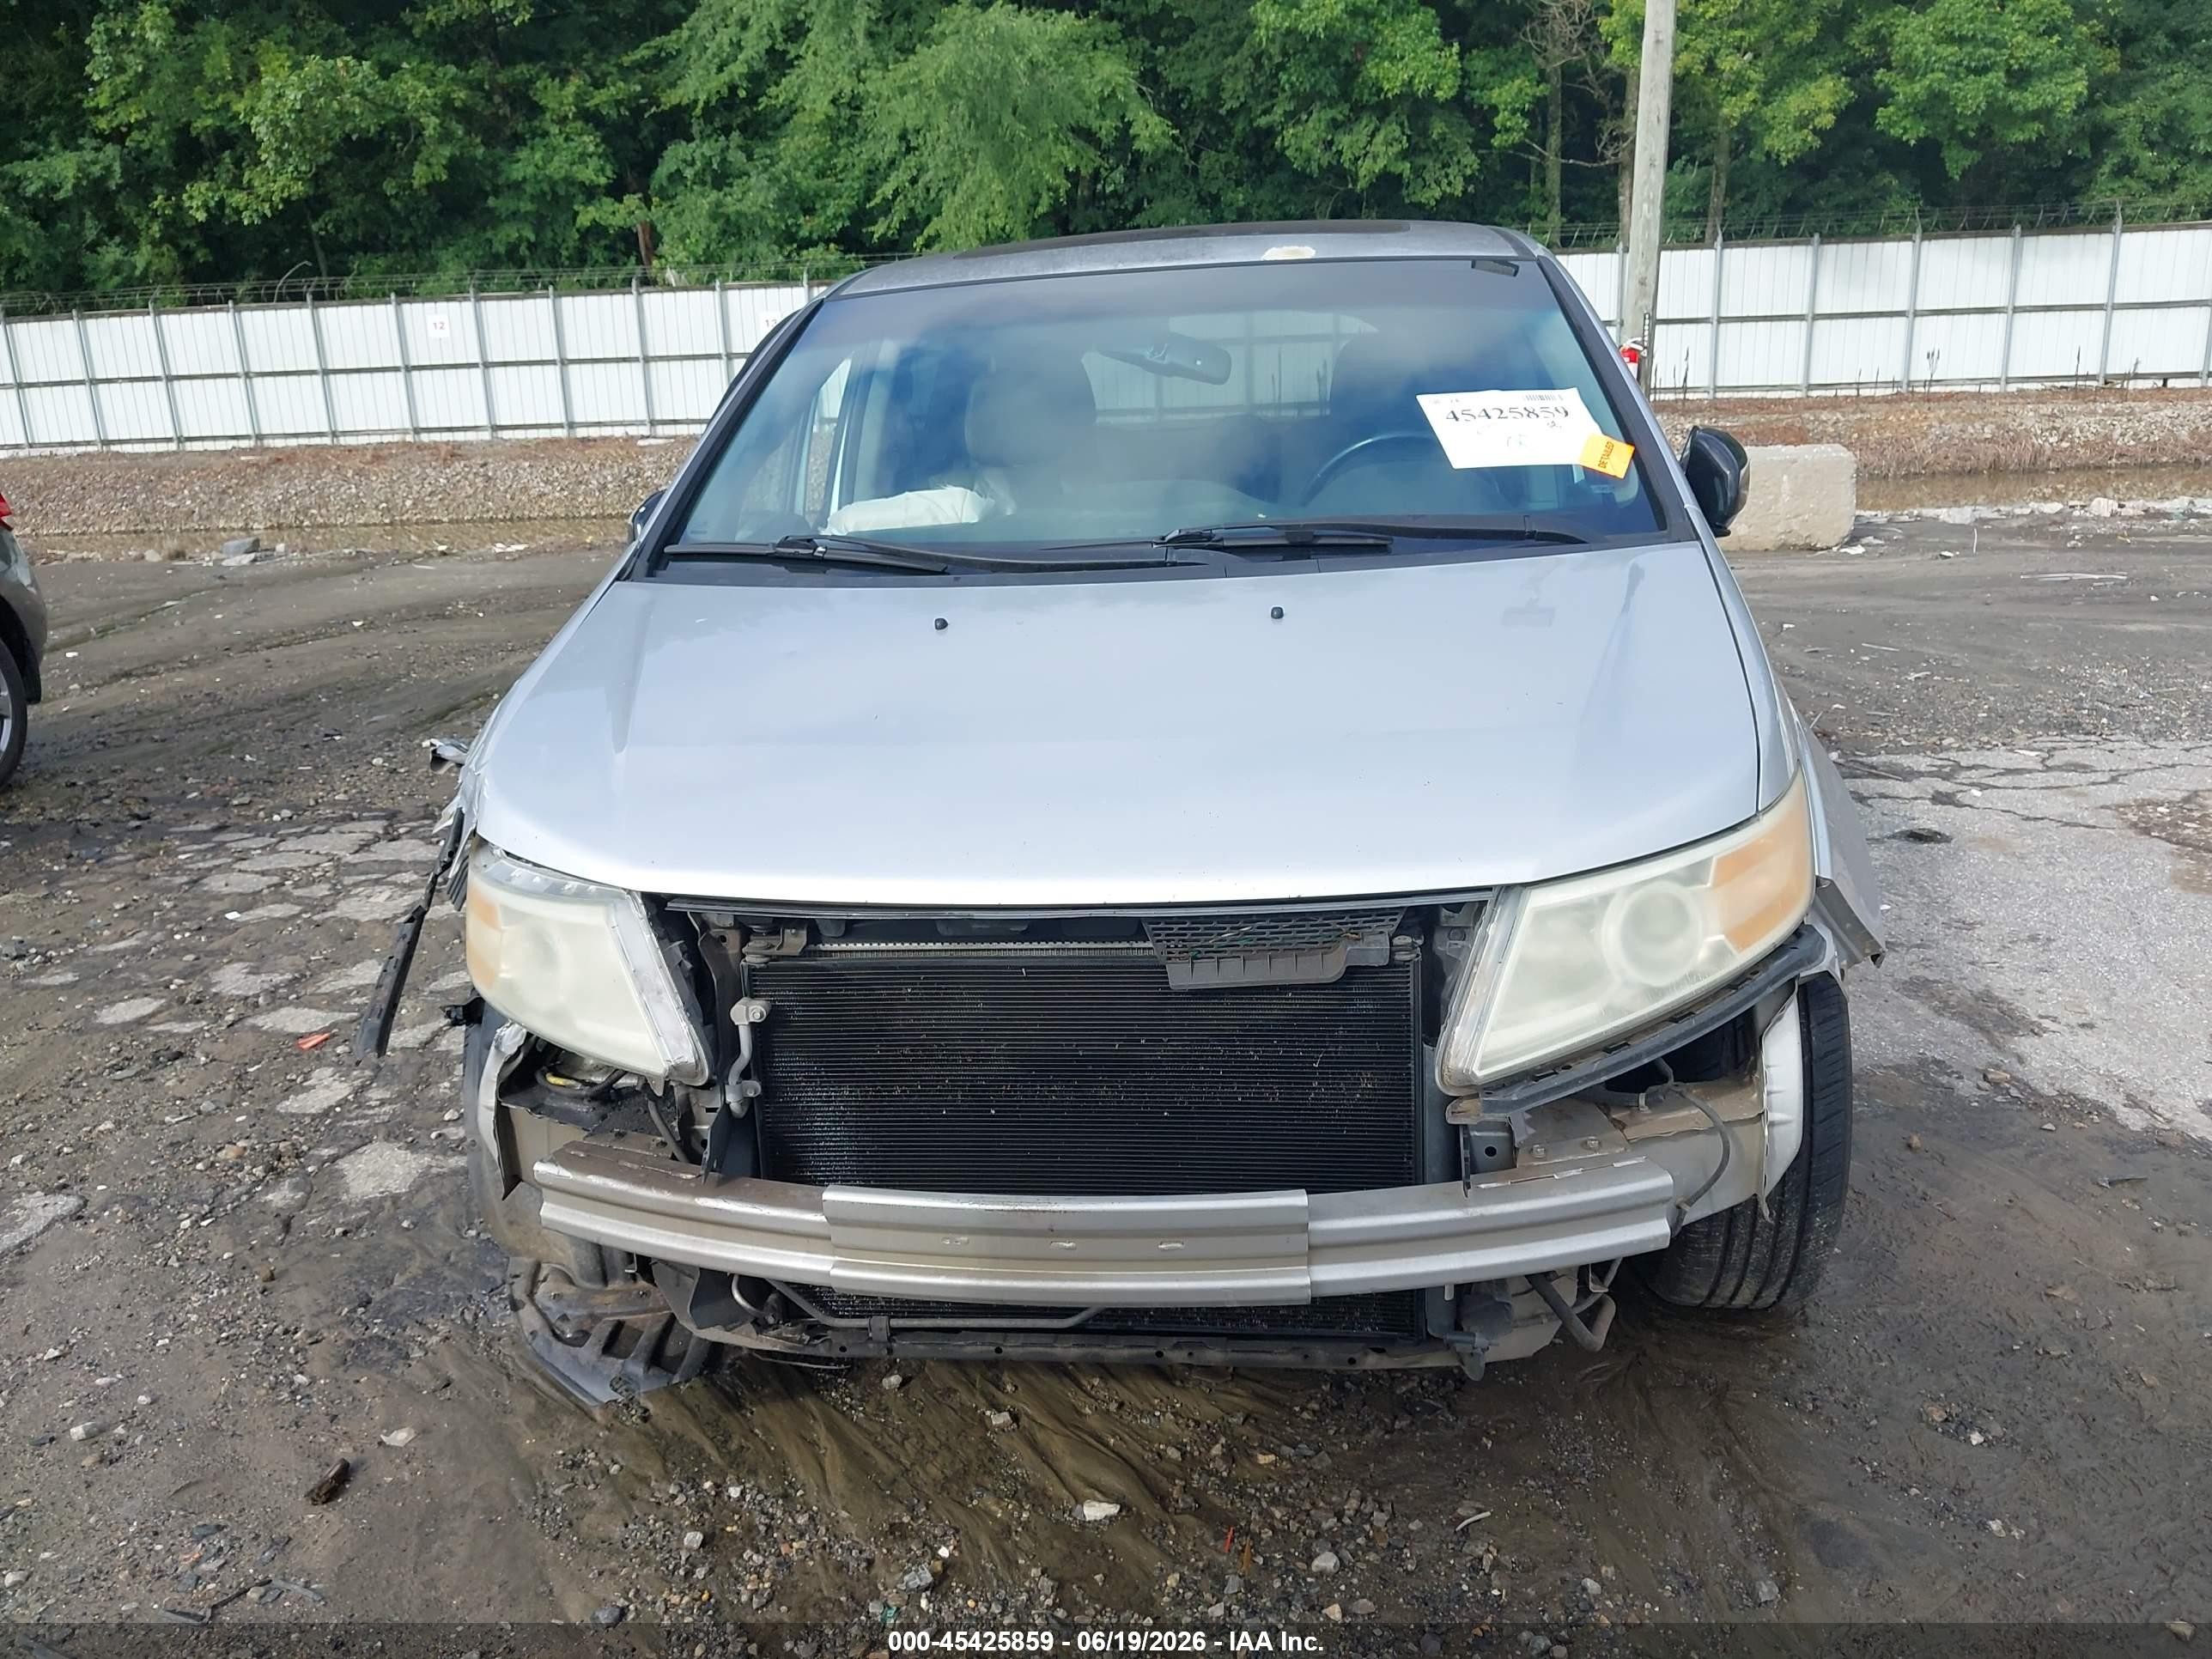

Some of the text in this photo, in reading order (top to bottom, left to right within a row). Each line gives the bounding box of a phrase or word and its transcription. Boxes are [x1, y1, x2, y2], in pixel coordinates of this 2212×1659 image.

[432, 321, 446, 331] 12
[1446, 406, 1569, 422] 45425859
[1598, 441, 1614, 469] DETAILED
